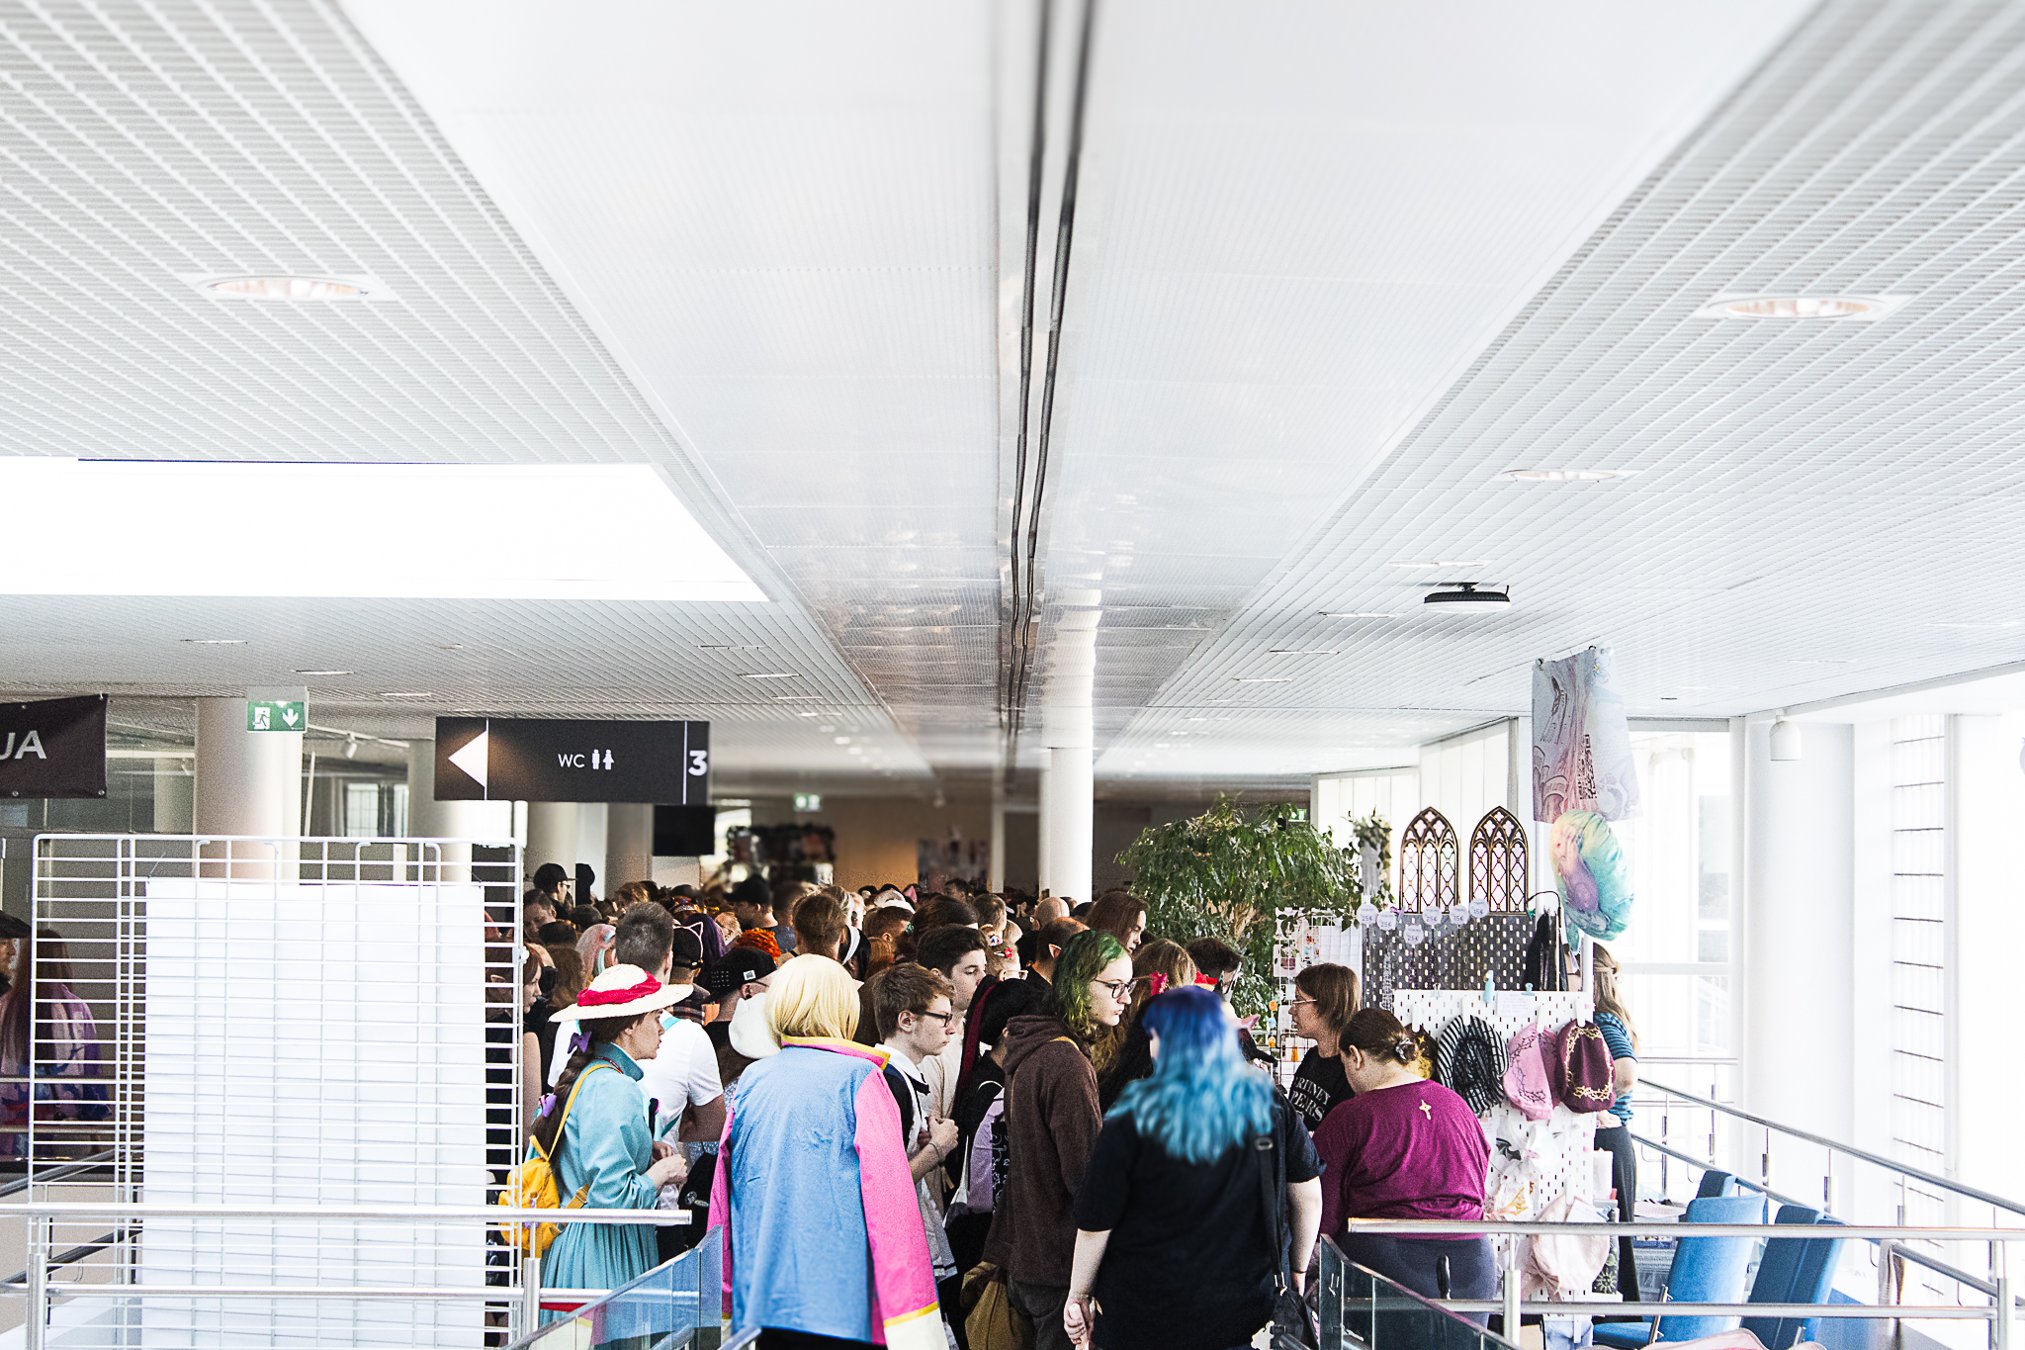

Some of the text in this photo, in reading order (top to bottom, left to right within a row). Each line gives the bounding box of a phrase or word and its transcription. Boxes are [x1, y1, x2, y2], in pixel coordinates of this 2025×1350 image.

[558, 753, 585, 768] WC
[688, 750, 708, 776] 3
[1290, 1091, 1326, 1121] PEARS
